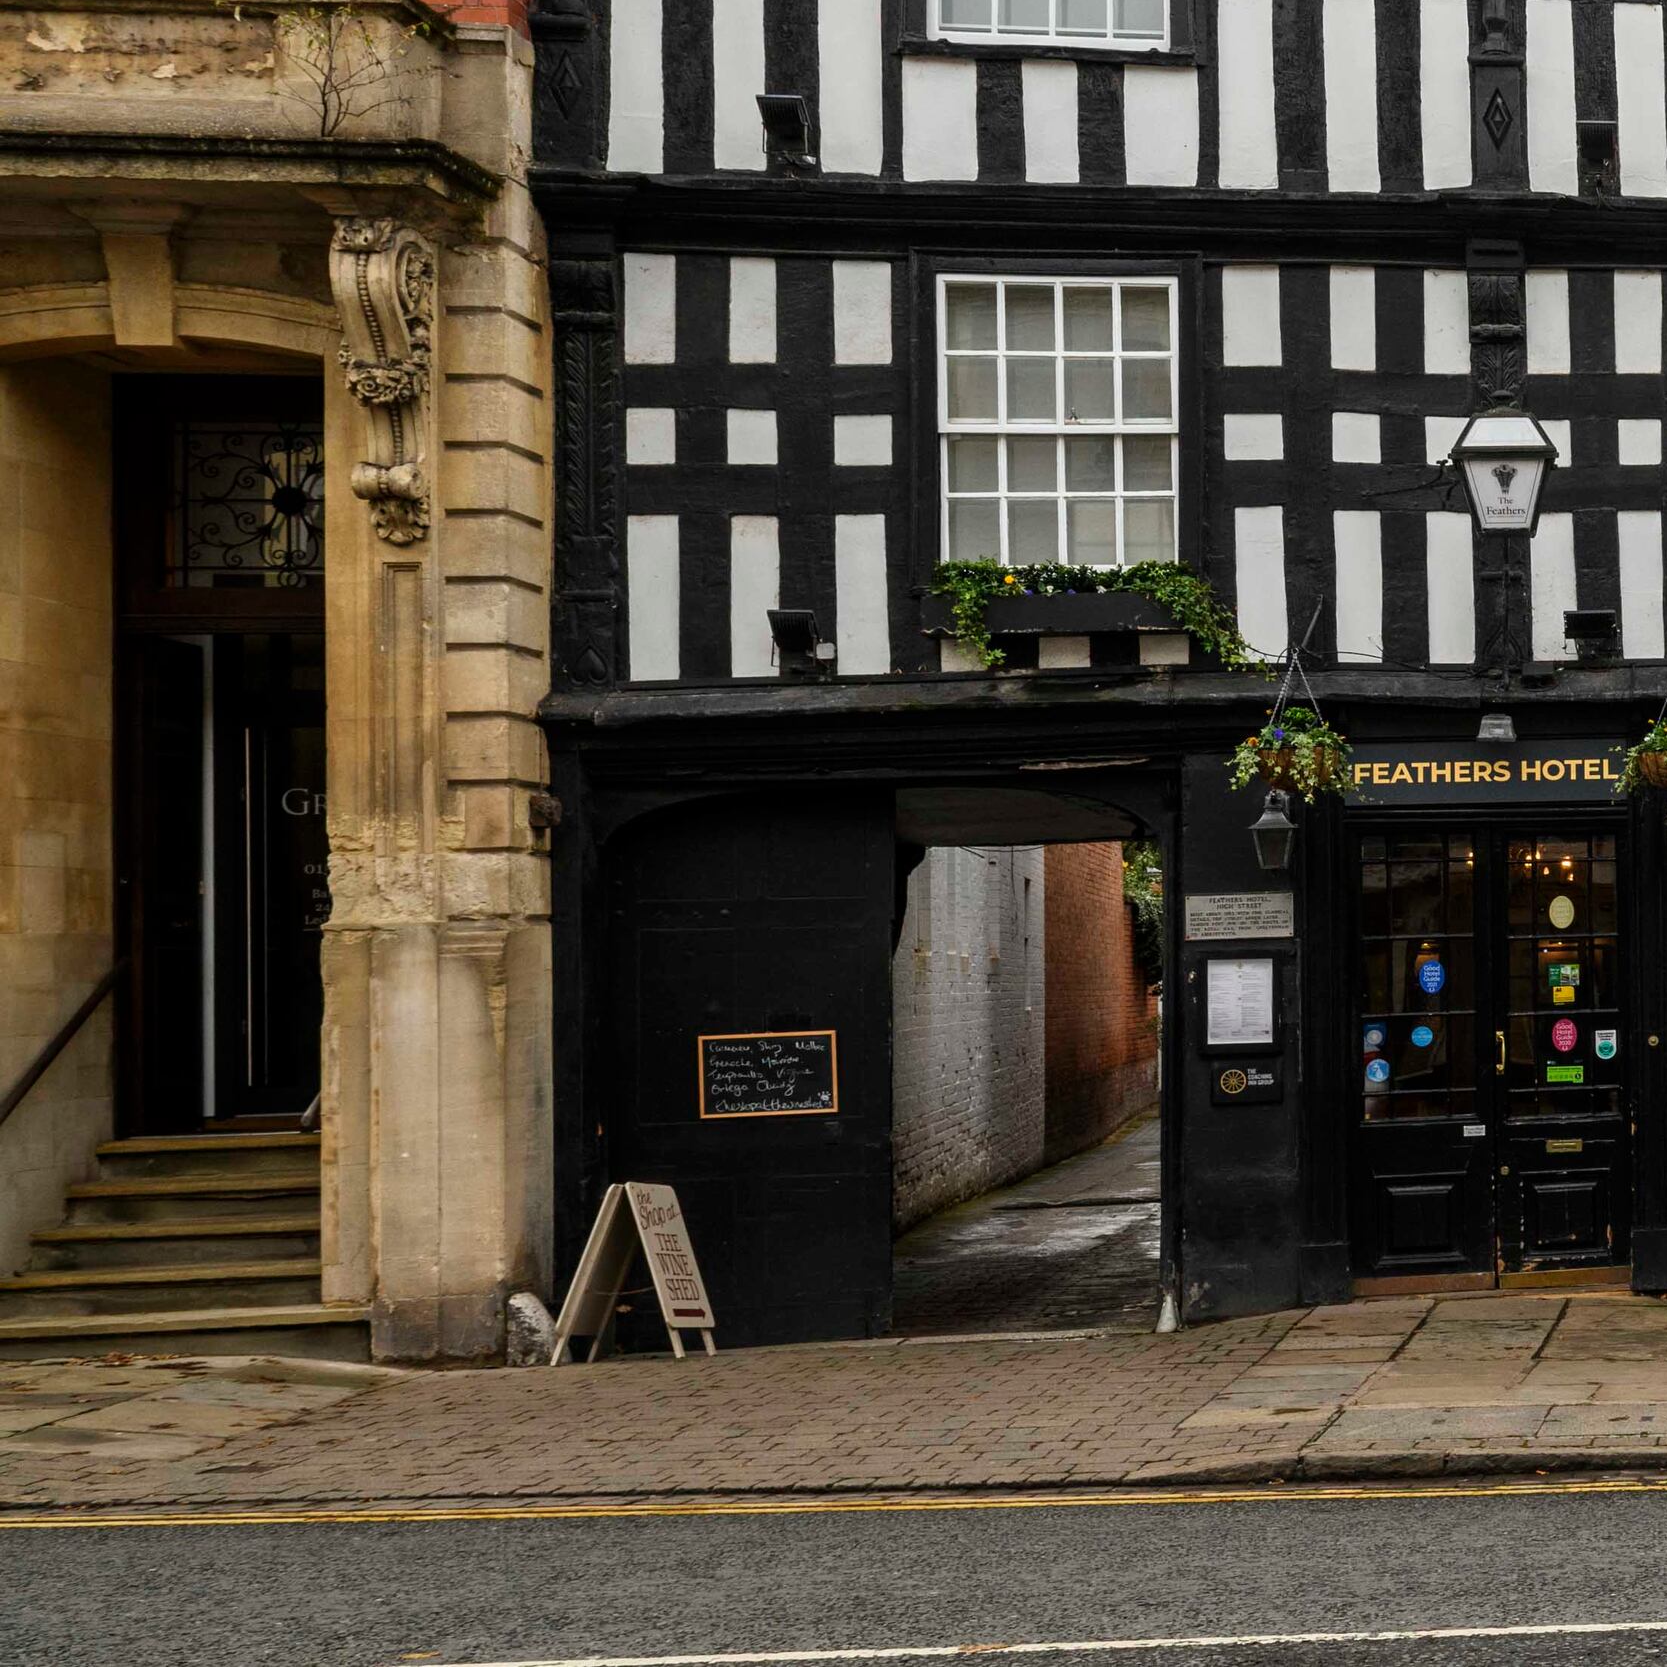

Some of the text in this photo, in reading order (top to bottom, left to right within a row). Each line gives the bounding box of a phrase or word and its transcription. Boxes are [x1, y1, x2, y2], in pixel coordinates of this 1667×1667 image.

[1486, 506, 1526, 515] Feathers
[1497, 496, 1513, 505] The
[1354, 758, 1619, 784] FEATHERS HOTEL
[654, 1233, 682, 1252] THE
[656, 1253, 693, 1276] WINE
[665, 1278, 700, 1301] SHED
